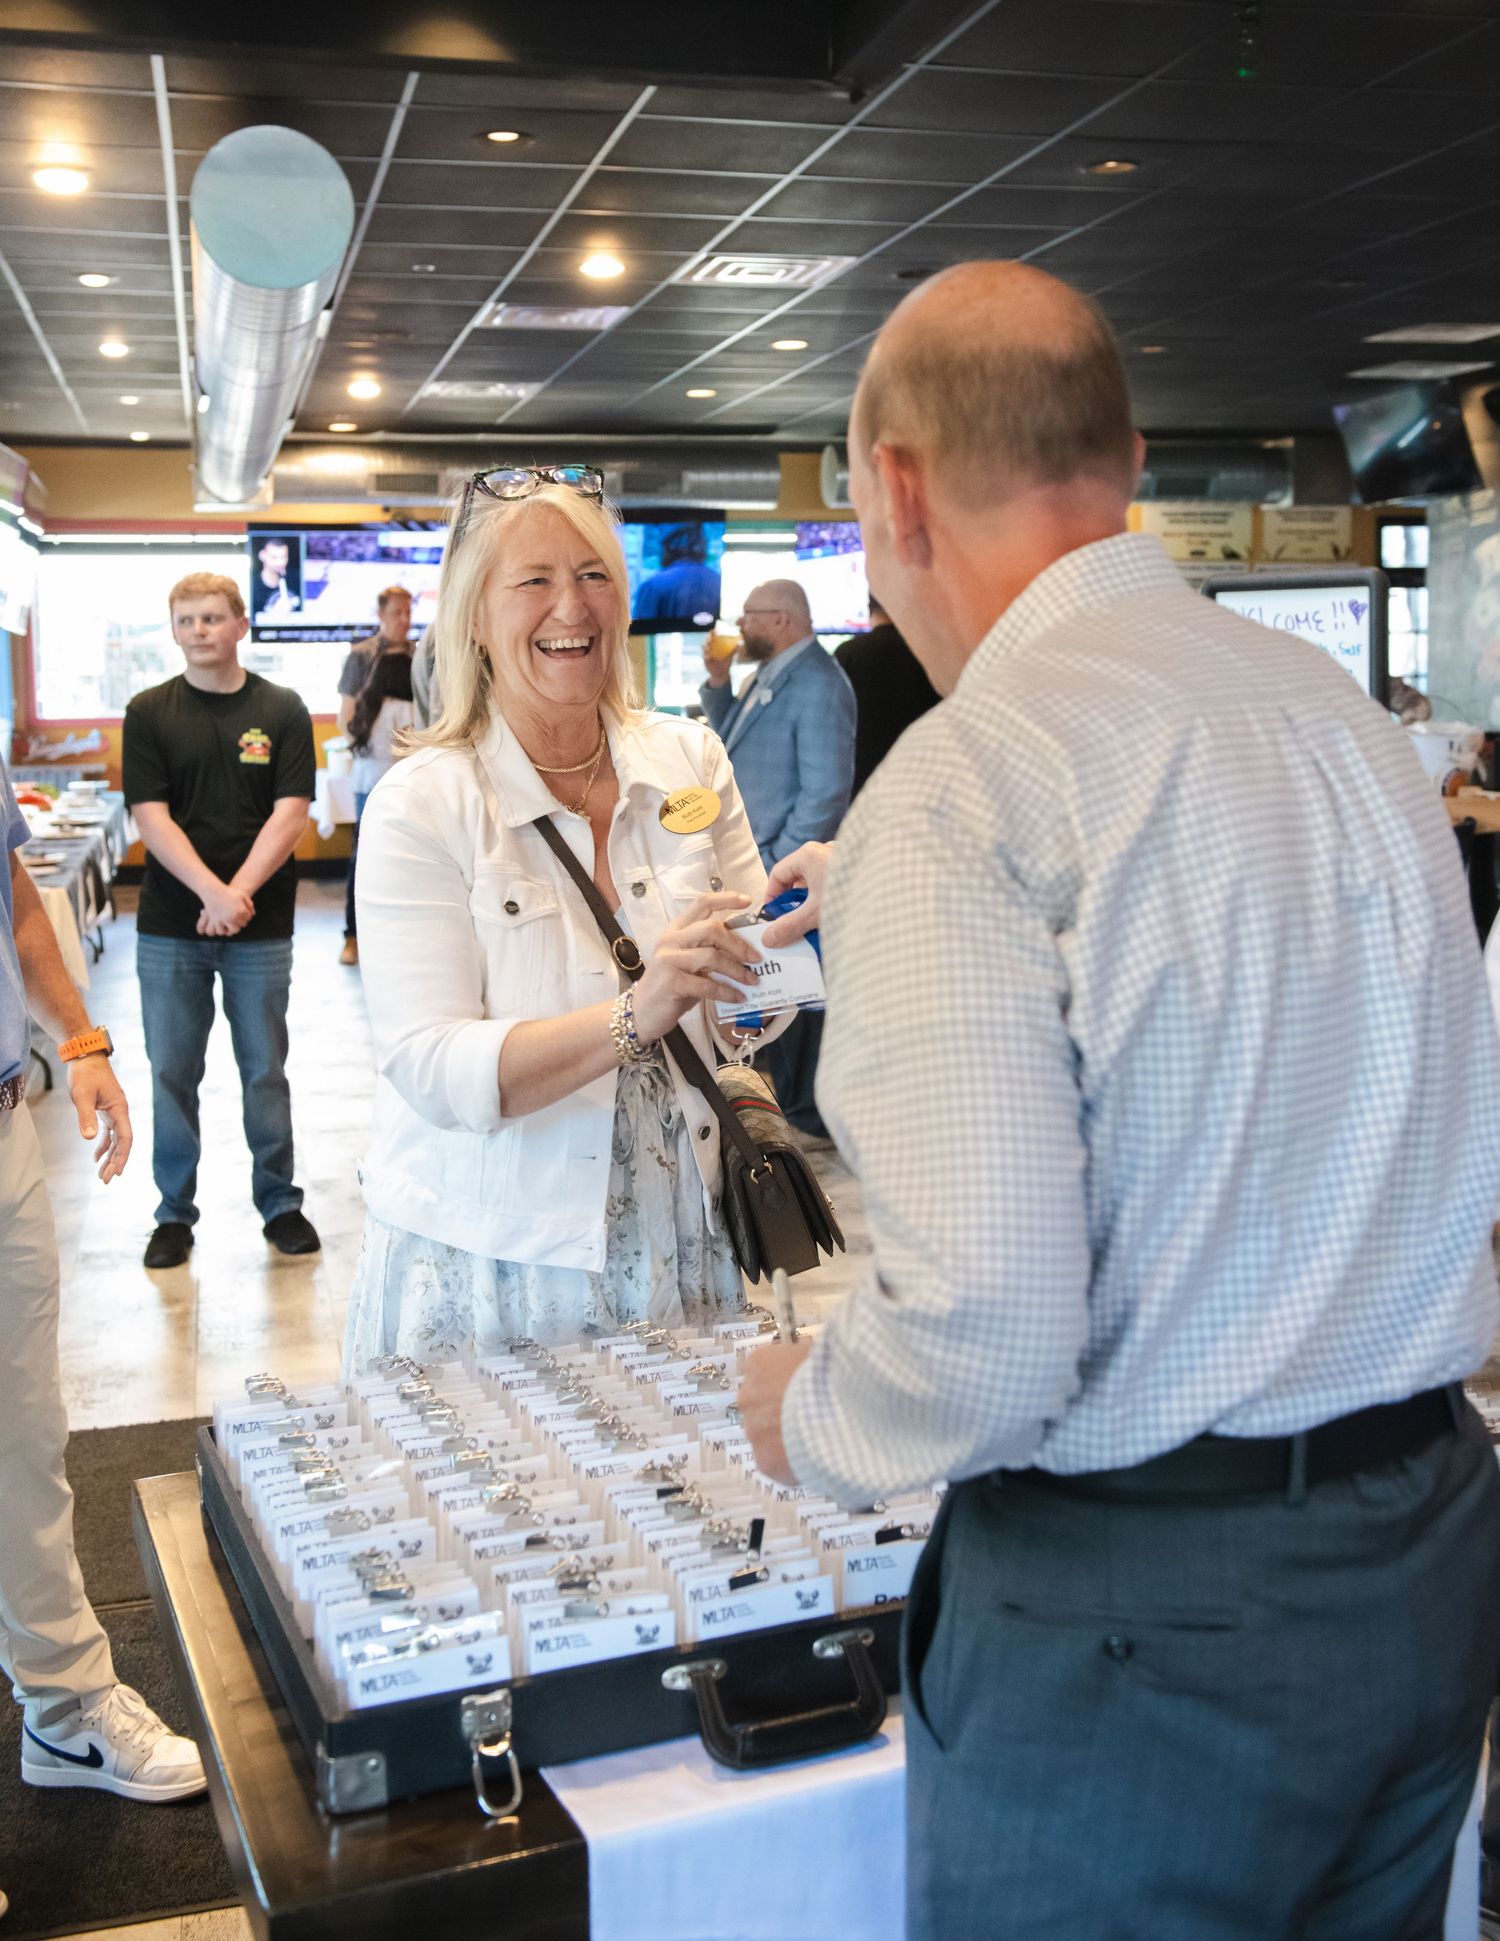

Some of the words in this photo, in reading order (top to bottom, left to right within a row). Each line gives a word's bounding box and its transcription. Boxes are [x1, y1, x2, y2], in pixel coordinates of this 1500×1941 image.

[664, 798, 690, 816] MLTA
[502, 1380, 528, 1391] MLTA
[636, 1372, 662, 1386] MLTA
[673, 1403, 700, 1417] MLTA
[232, 1421, 262, 1435] MLTA
[243, 1447, 274, 1461] MLTA
[405, 1447, 434, 1460] MLTA
[585, 1464, 615, 1480] MLTA
[777, 1488, 806, 1503] MLTA
[280, 1521, 313, 1538] MLTA
[822, 1535, 853, 1552] MLTA
[474, 1545, 507, 1561] MLTA
[303, 1554, 336, 1572] MLTA
[847, 1557, 878, 1573] MLTA
[689, 1585, 721, 1604] MLTA
[702, 1605, 736, 1625] MLTA
[535, 1636, 570, 1654] MLTA
[361, 1674, 399, 1695] MLTA
